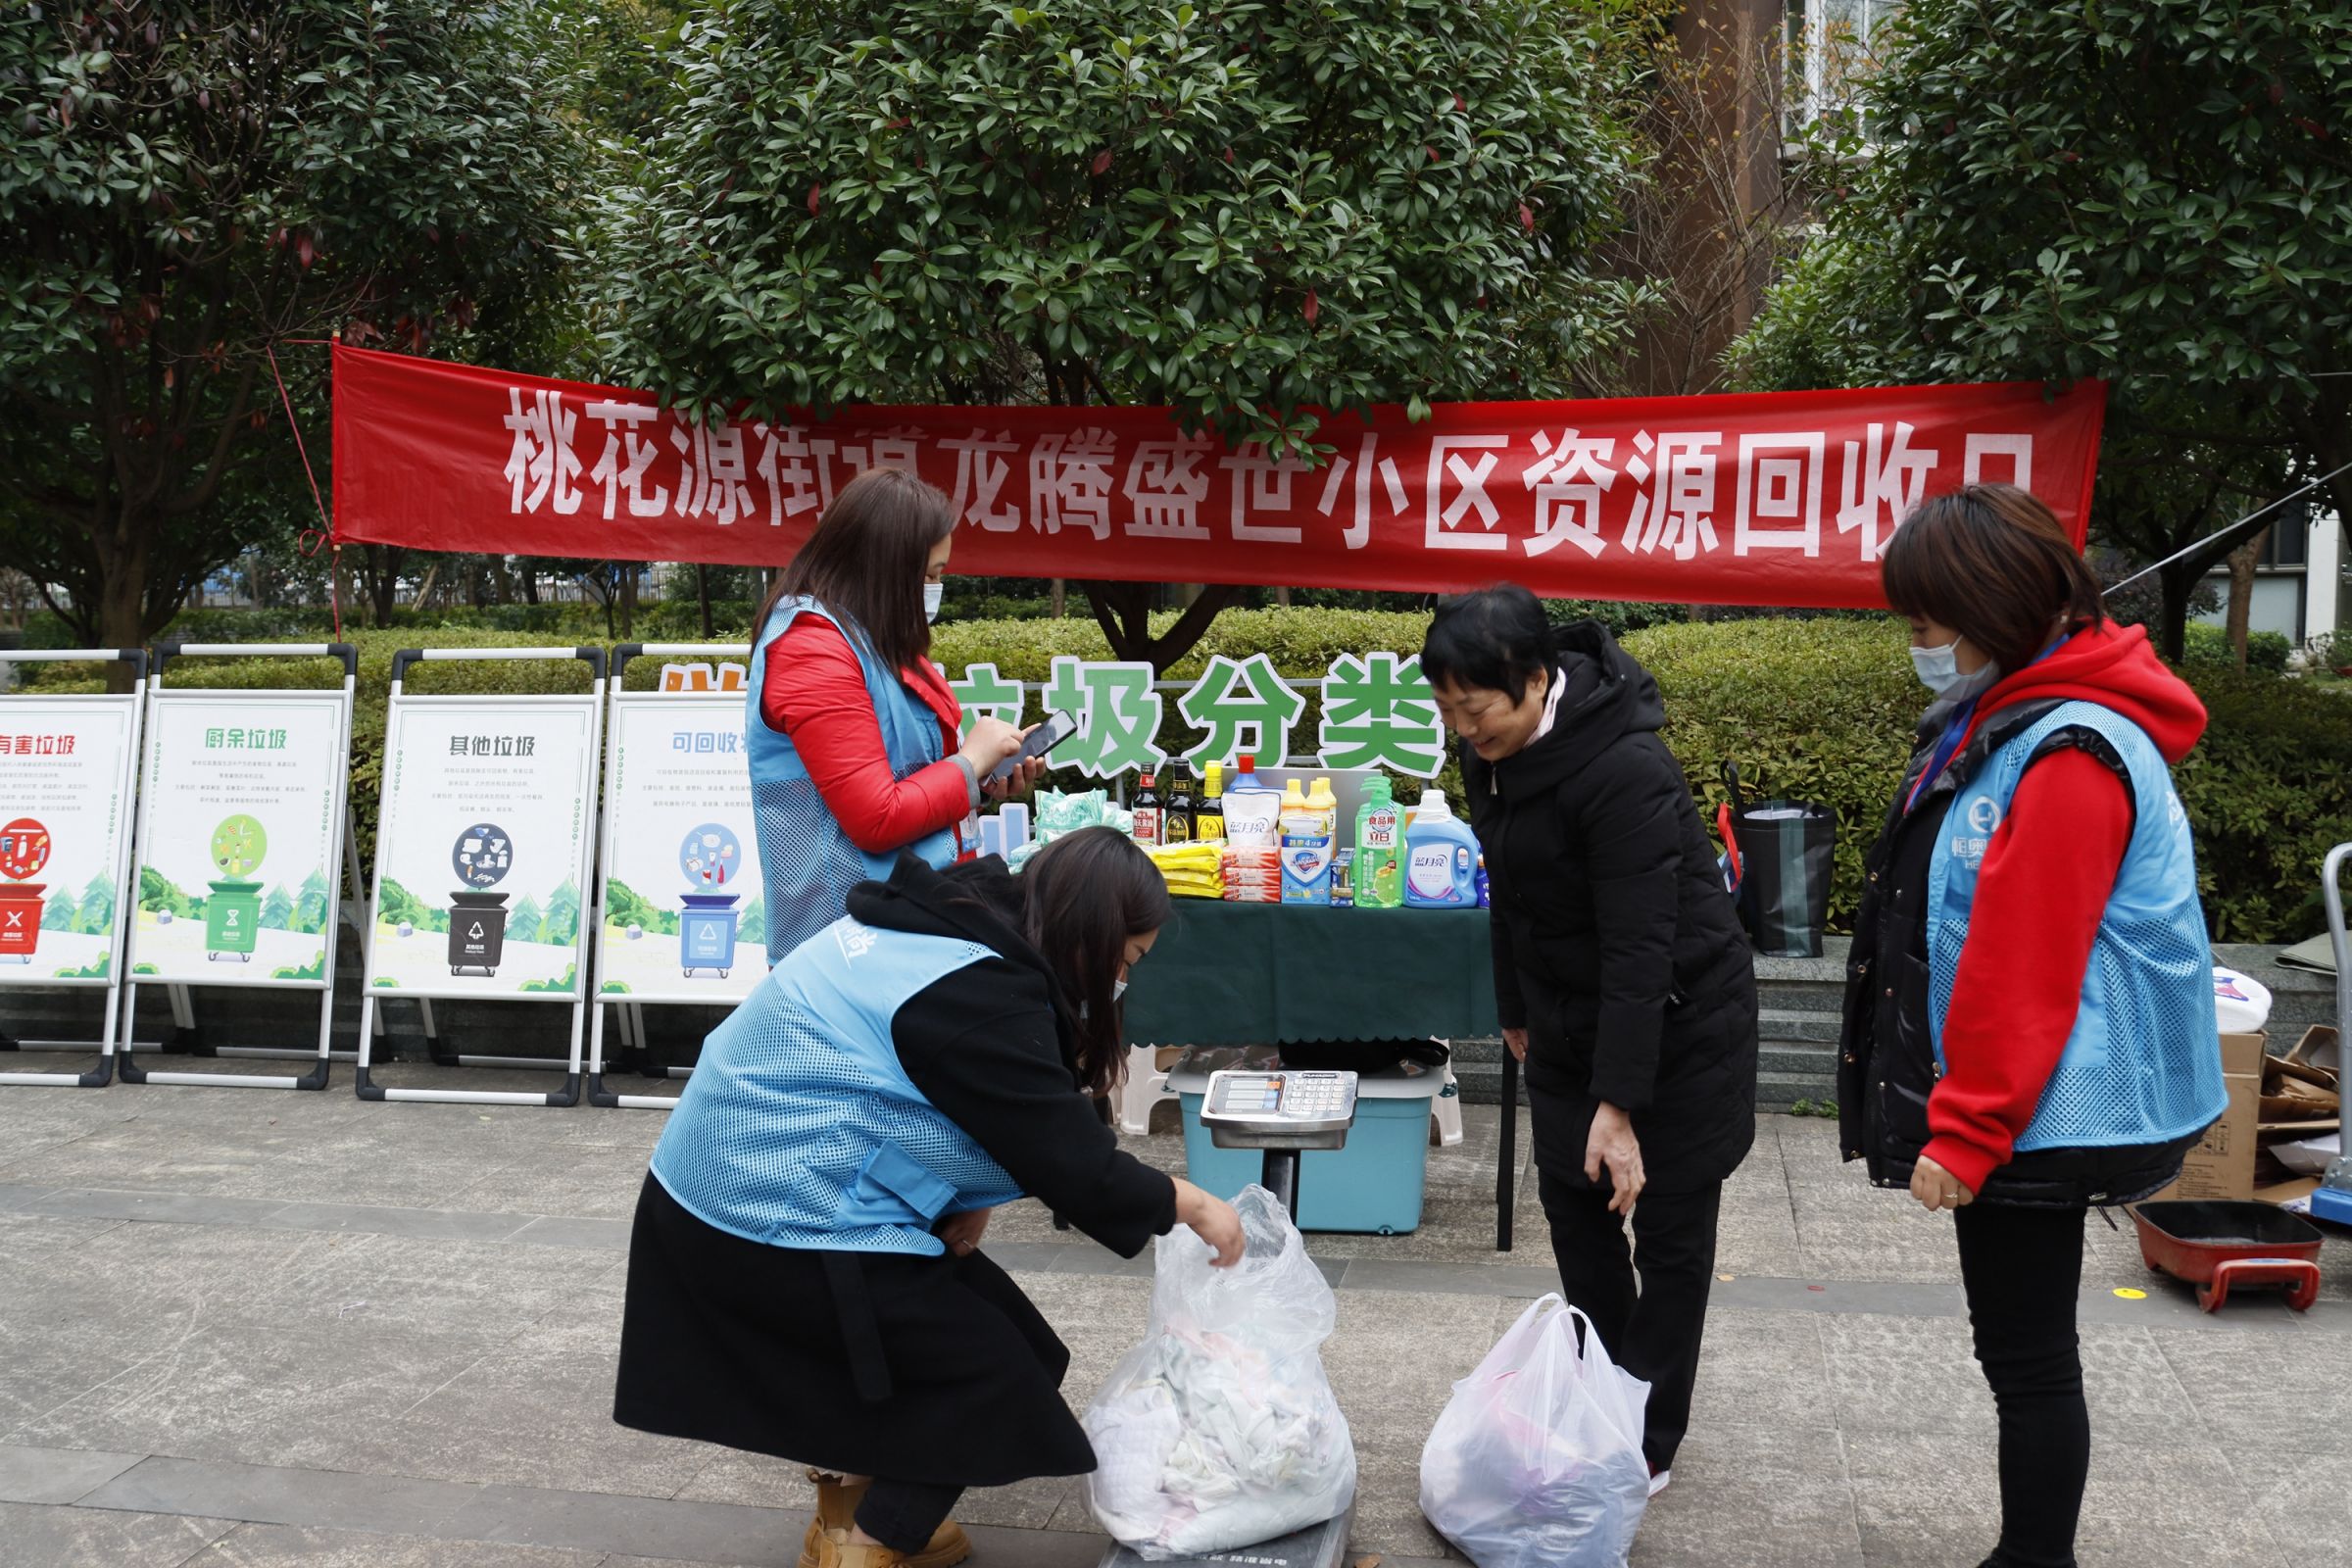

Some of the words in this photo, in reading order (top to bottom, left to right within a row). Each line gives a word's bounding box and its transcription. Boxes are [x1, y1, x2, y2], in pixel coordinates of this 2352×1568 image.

[0, 735, 75, 755] 有害垃圾
[205, 728, 287, 749] 厨余垃圾
[449, 735, 535, 757] 其他垃圾
[1229, 821, 1266, 833] 蓝月亮
[1368, 815, 1396, 825] 食品用
[1414, 857, 1446, 867] 蓝月亮
